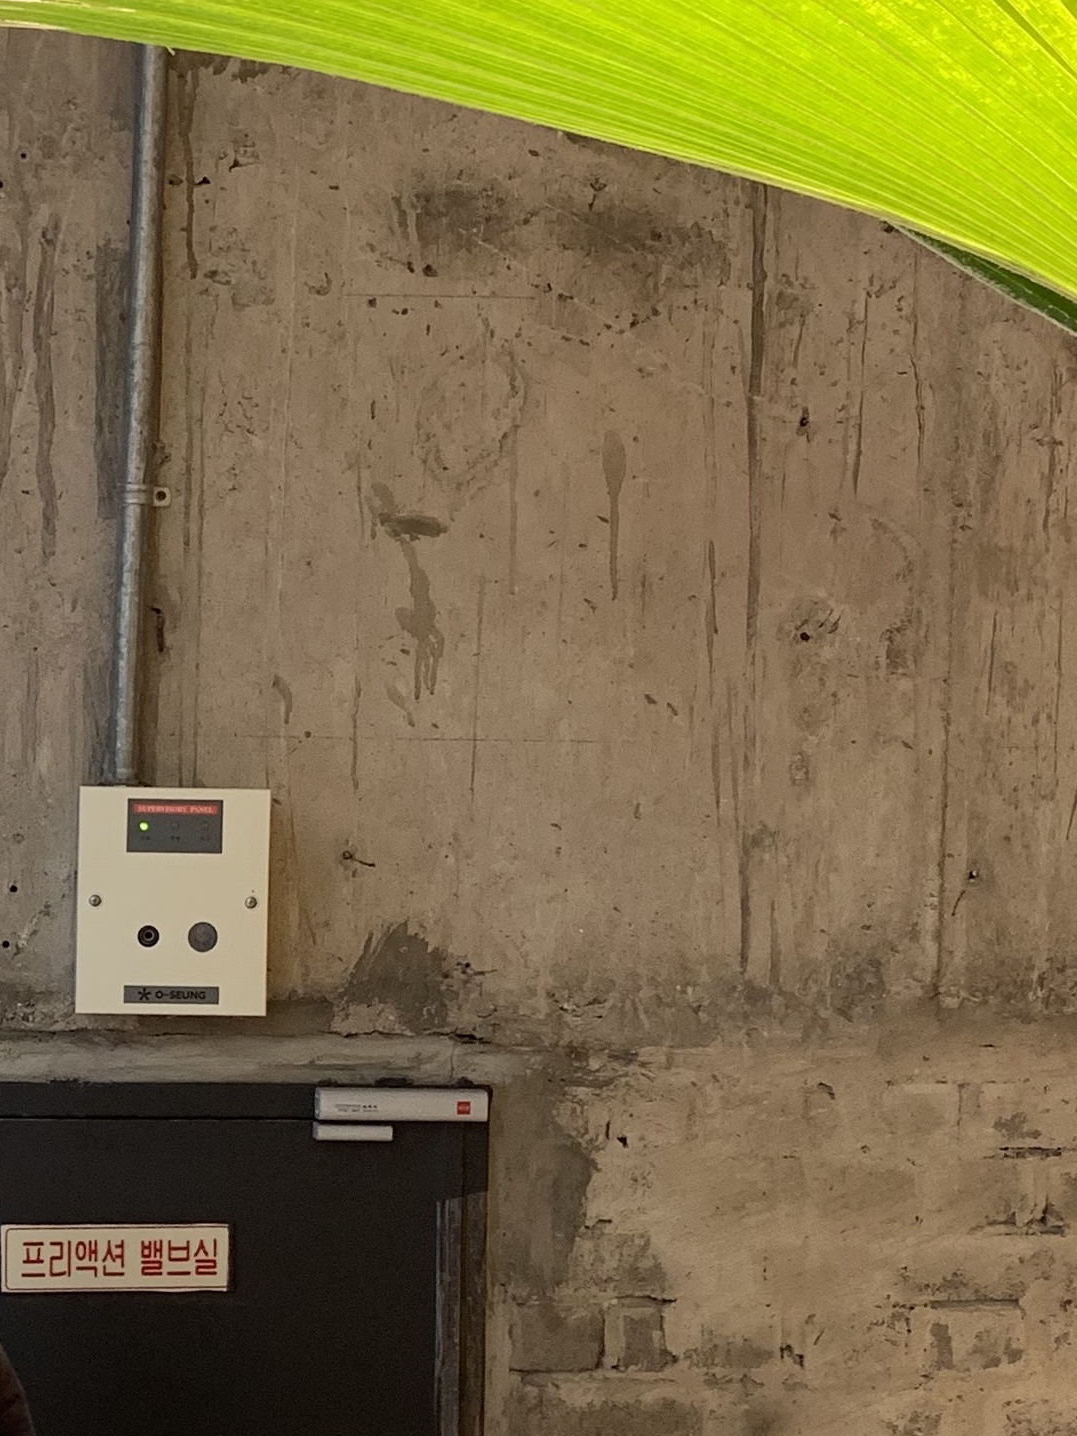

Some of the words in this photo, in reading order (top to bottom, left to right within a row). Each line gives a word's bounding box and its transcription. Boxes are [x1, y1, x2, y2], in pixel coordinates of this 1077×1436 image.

[155, 990, 206, 1000] O-SEUNG
[21, 1240, 126, 1278] 프리액션
[140, 1238, 218, 1277] 밸브실
